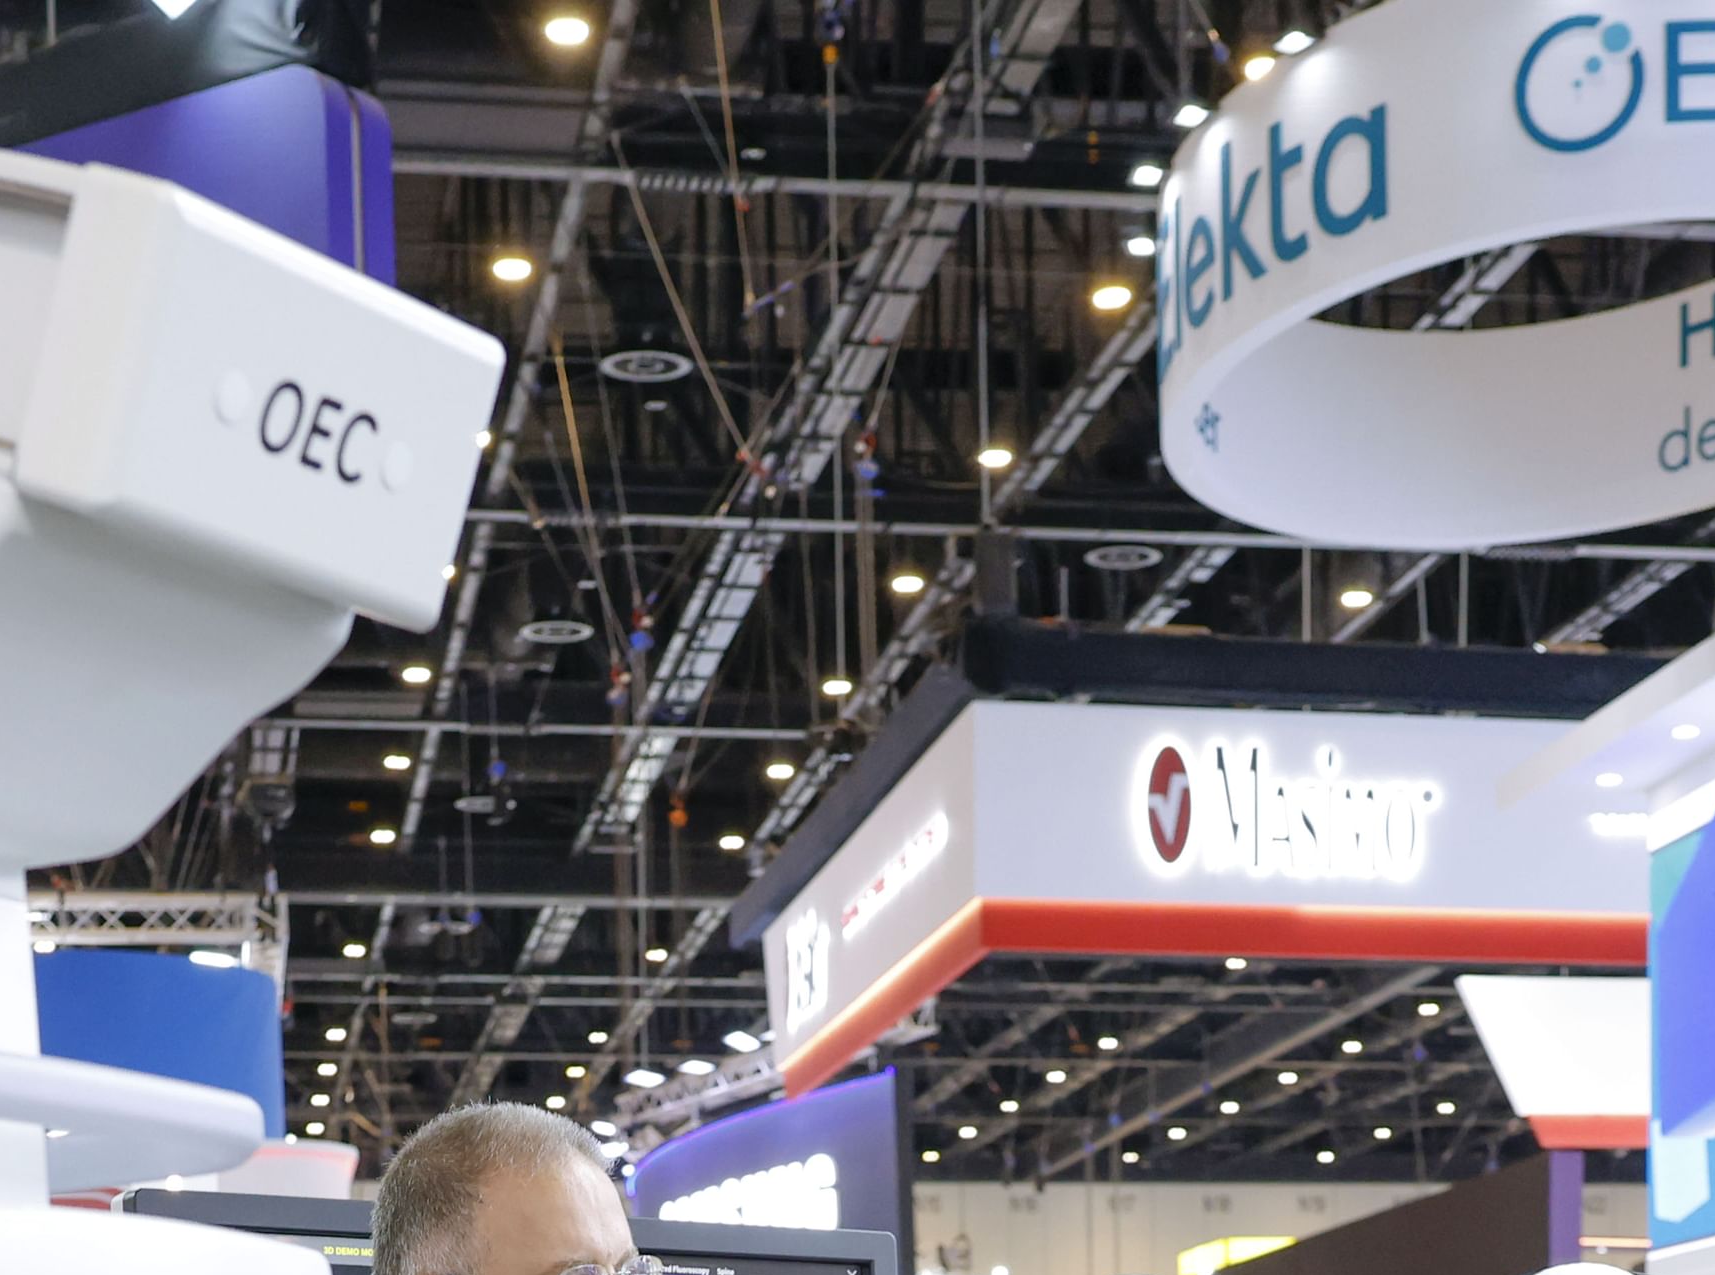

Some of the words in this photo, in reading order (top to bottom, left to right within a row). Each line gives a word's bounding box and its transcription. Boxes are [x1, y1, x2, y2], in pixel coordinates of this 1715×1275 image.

[258, 380, 380, 483] OEC
[335, 1246, 360, 1256] DEMO
[361, 1248, 375, 1257] MO
